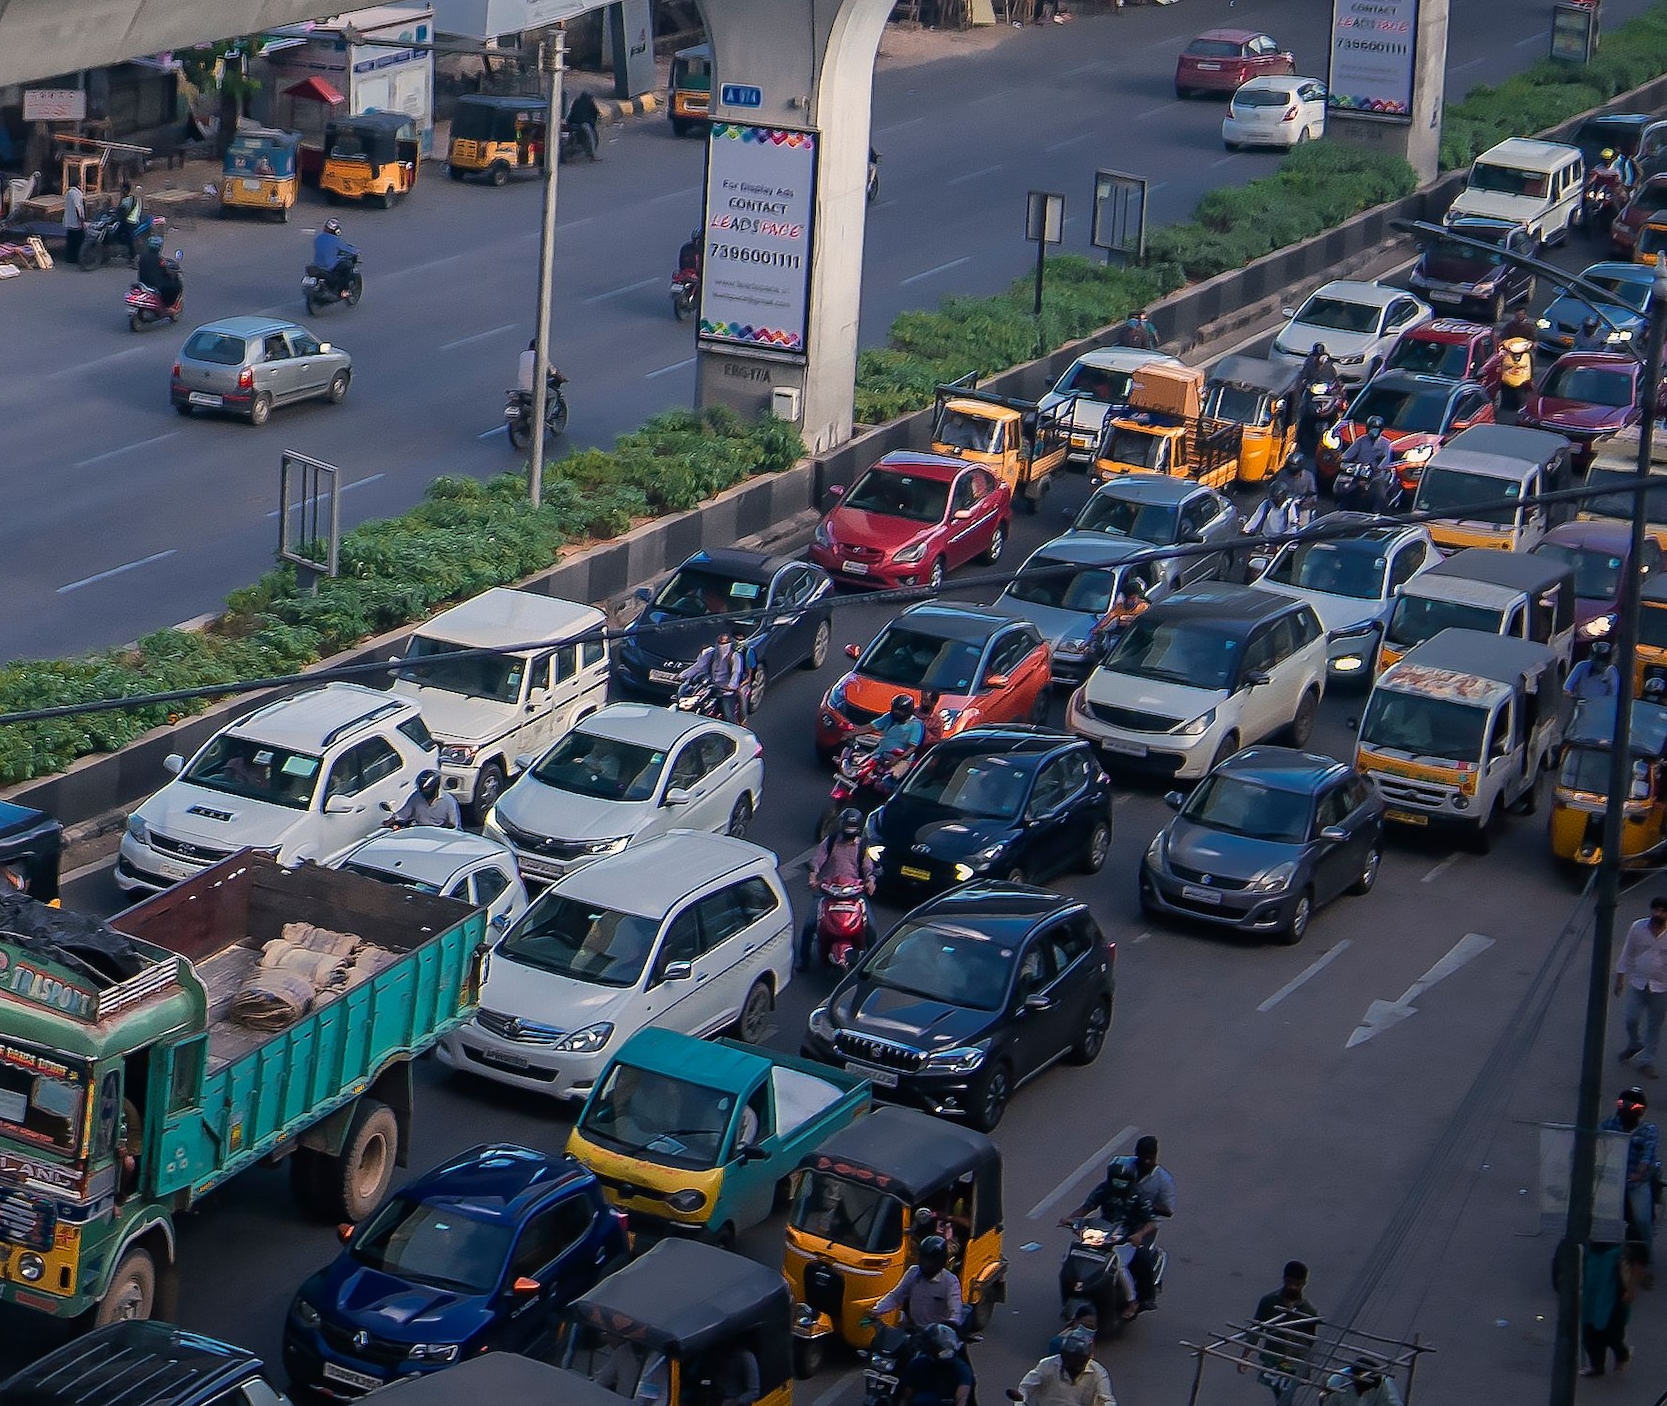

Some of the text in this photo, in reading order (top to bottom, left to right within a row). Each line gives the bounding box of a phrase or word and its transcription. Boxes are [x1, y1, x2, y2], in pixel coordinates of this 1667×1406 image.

[729, 197, 788, 216] CONTACT
[710, 213, 803, 239] LEADSPACE
[710, 243, 801, 270] 7396001111
